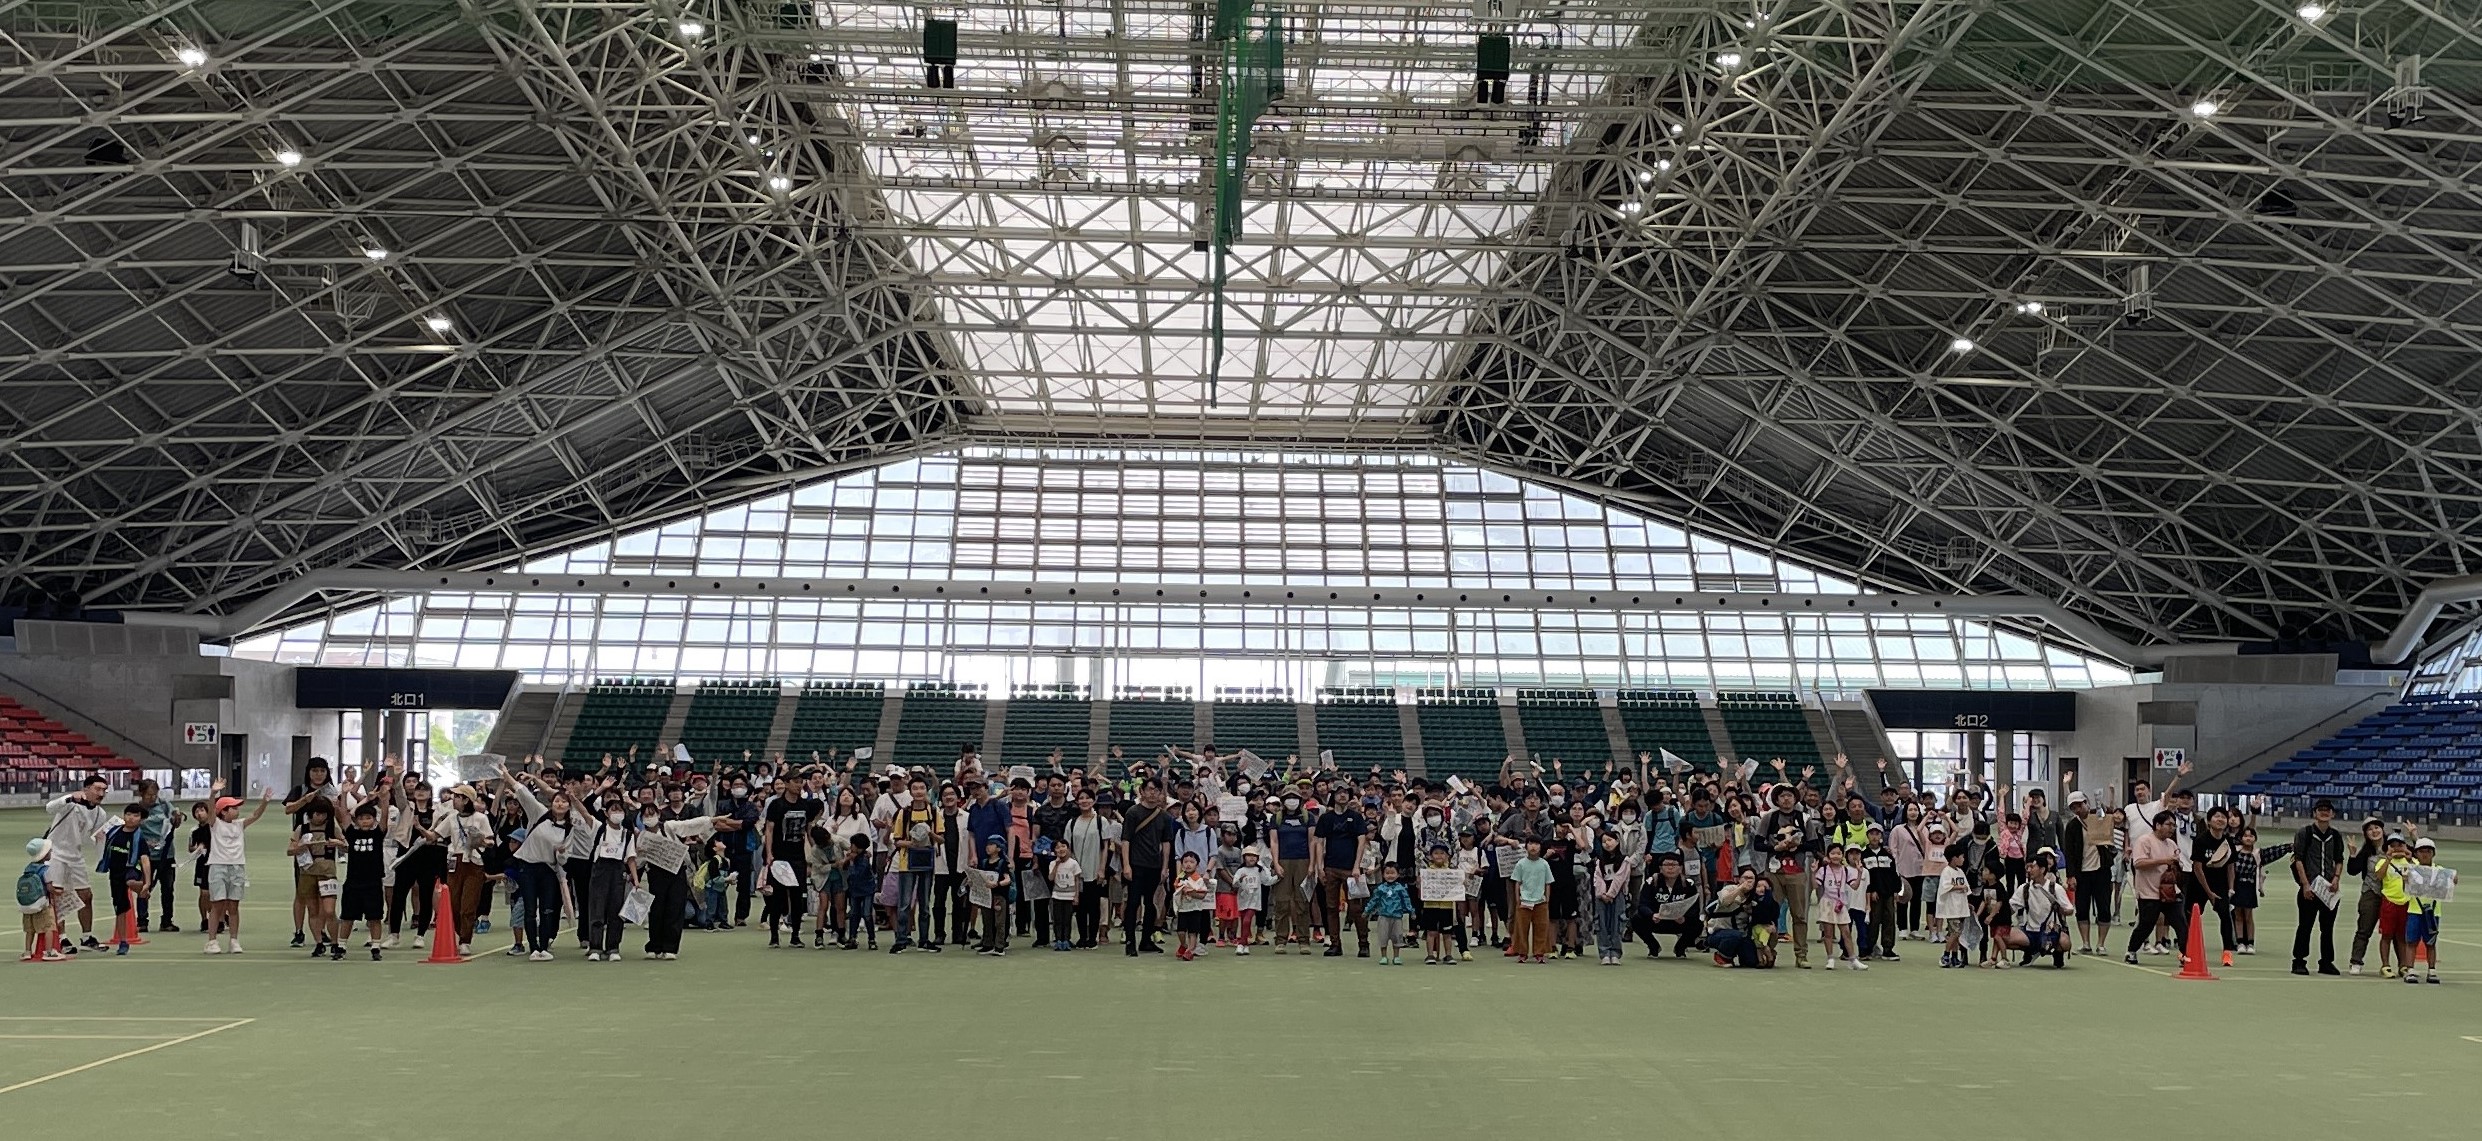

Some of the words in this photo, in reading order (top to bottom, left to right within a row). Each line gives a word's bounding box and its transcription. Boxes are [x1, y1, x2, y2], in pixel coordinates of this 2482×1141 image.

[391, 692, 424, 706] 北口1
[1954, 713, 1988, 727] 北口2
[195, 724, 207, 732] WC
